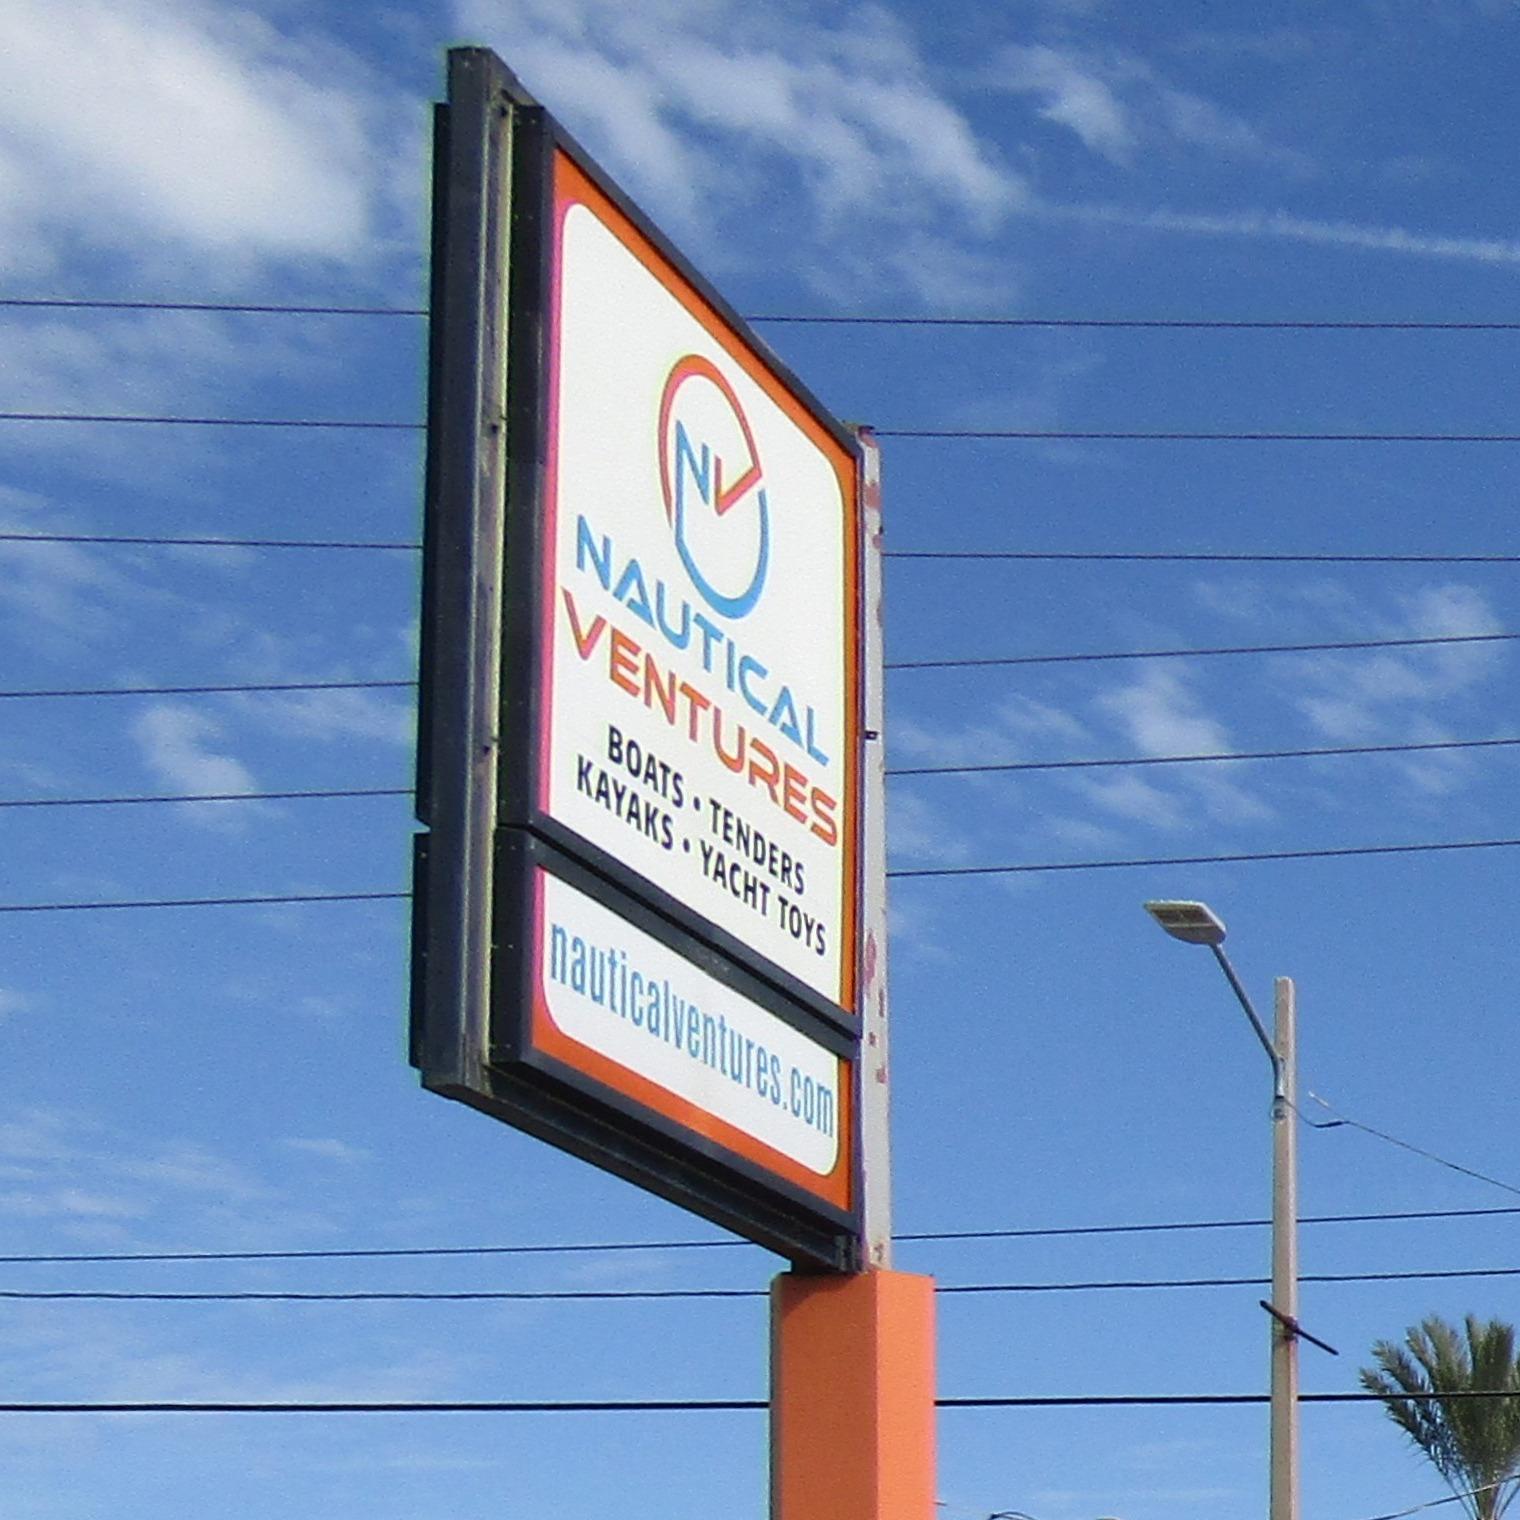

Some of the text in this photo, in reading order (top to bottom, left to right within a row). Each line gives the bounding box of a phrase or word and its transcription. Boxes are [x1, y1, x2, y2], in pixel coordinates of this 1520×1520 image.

[561, 585, 838, 847] VENTURES
[576, 514, 829, 766] NAUTICAL
[577, 754, 826, 956] KAYAKS YACHT TOYS
[608, 724, 804, 895] BOATS TENDERS
[551, 923, 833, 1138] nauticalventures.com
